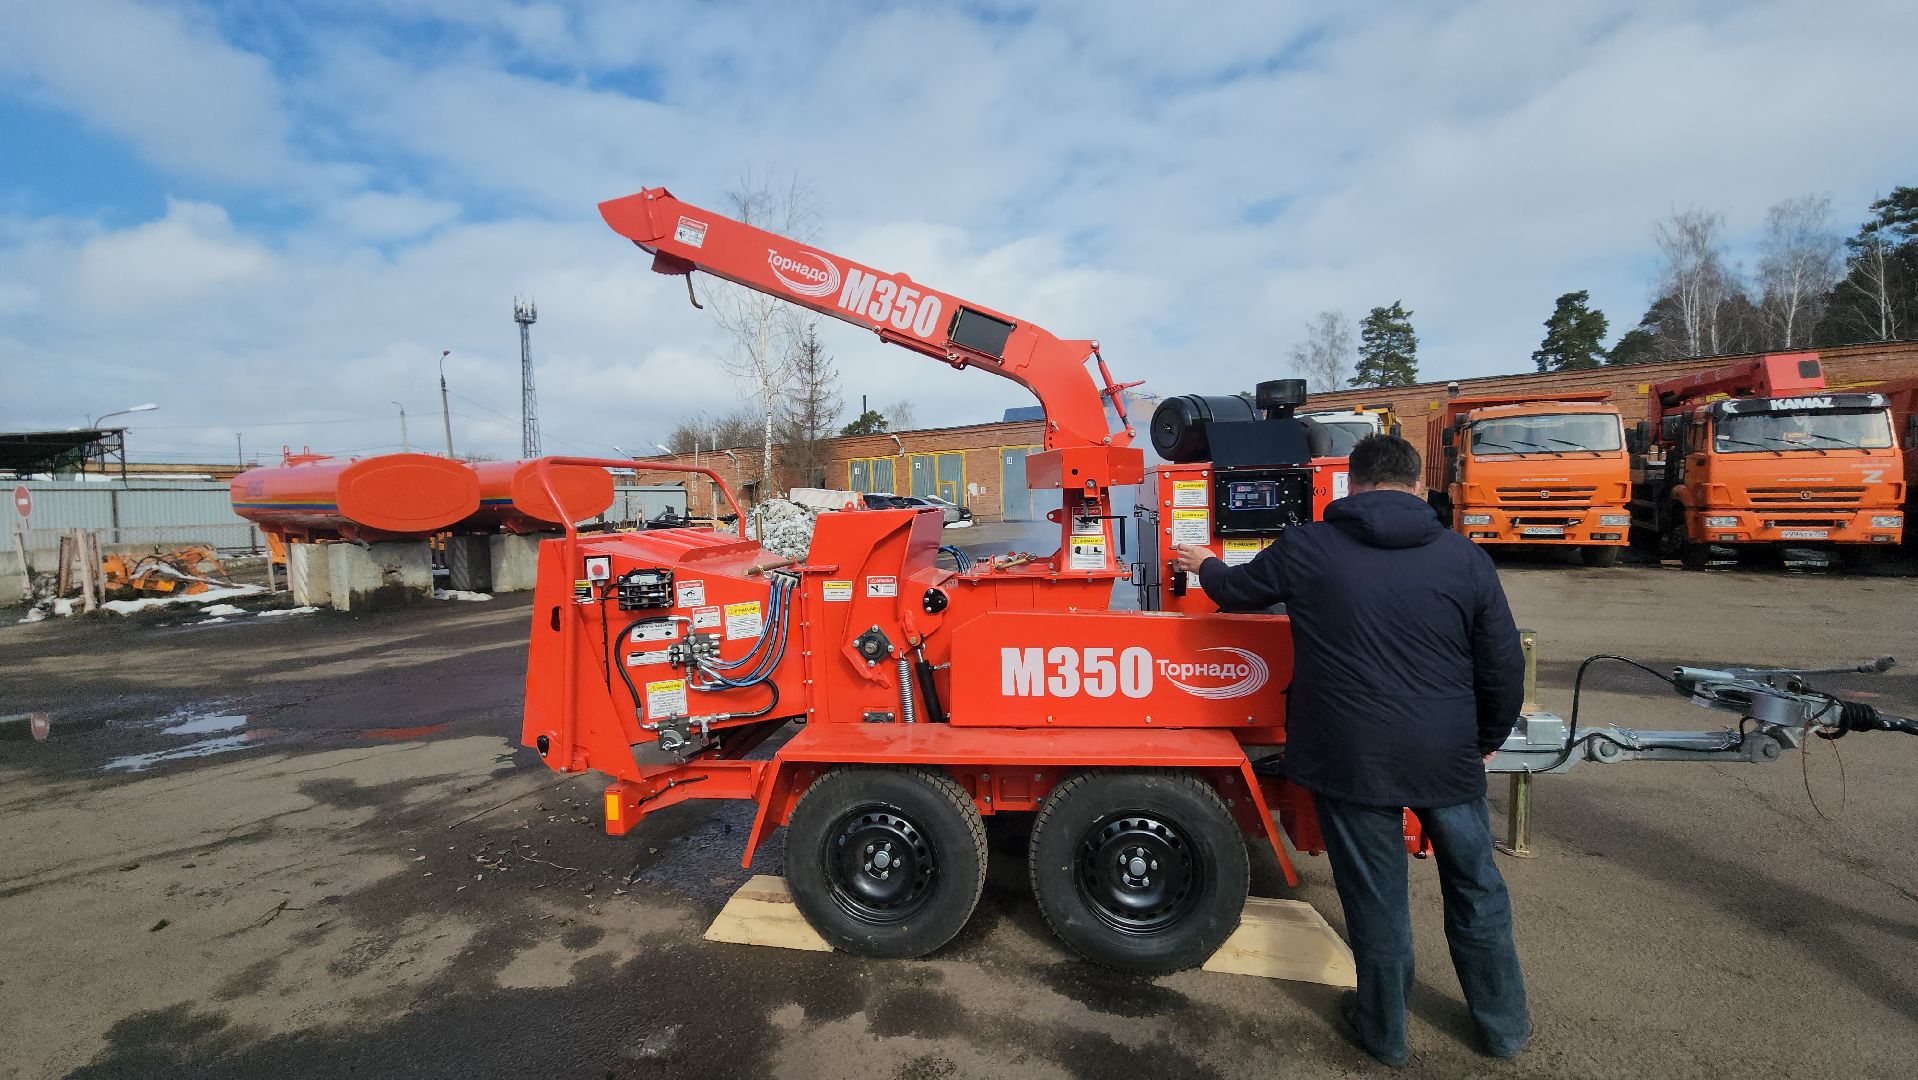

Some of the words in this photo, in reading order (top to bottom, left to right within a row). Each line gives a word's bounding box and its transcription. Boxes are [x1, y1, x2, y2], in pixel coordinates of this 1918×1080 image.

[767, 248, 829, 283] Торнадо
[1769, 397, 1834, 411] KAMAZ
[1862, 470, 1884, 484] Z
[1156, 659, 1250, 681] Торнадо
